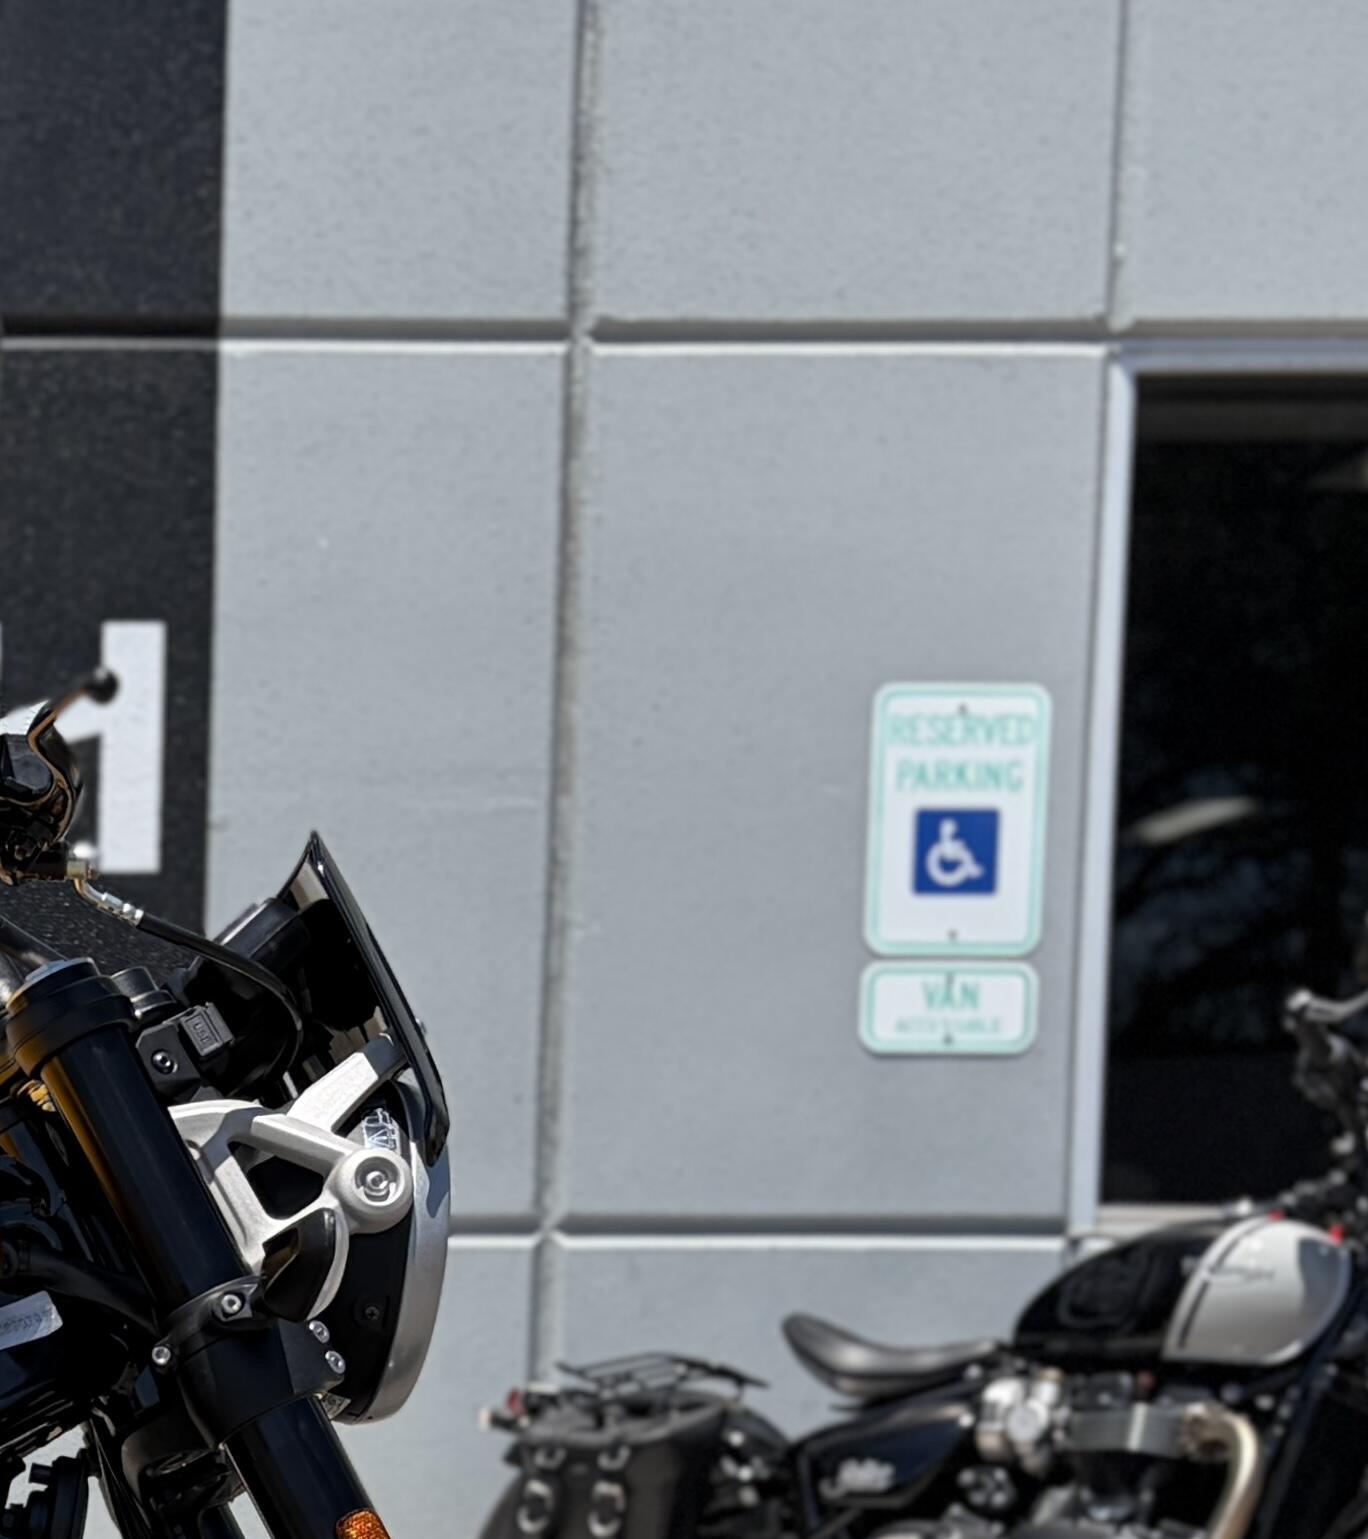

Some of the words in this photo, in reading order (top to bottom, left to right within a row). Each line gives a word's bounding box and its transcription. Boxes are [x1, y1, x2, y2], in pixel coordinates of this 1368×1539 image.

[887, 713, 1035, 747] RESERVED
[895, 760, 1024, 792] PARKING
[921, 981, 980, 1010] VAN
